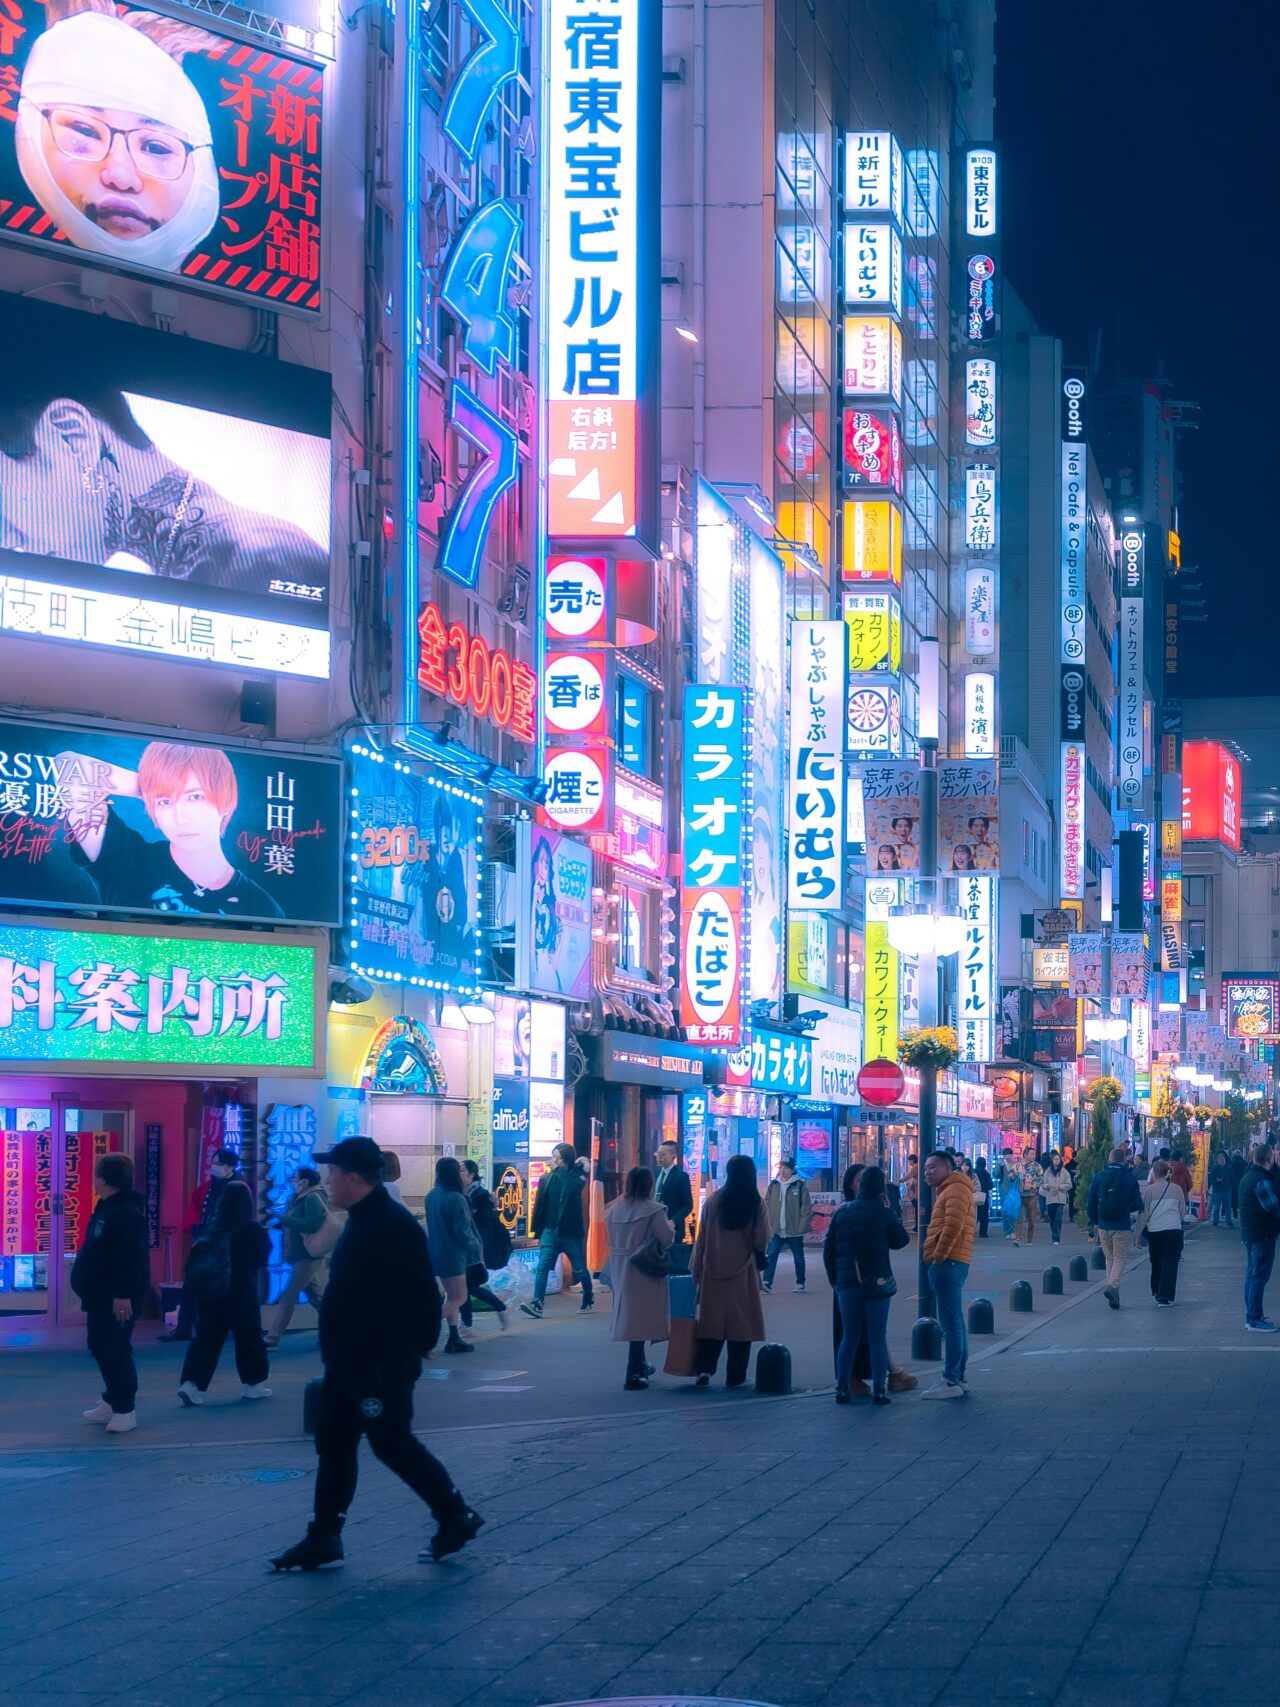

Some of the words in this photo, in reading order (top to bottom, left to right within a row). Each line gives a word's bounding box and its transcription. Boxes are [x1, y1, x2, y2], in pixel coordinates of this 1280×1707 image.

[219, 75, 268, 257] オープン
[264, 86, 320, 281] 新店舗
[856, 136, 880, 208] 川新ビル
[563, 0, 623, 396] 宿東宝ビル店
[973, 166, 990, 229] 東京ビル
[857, 228, 878, 300] にいむら
[860, 324, 878, 391] ととりこ
[570, 407, 613, 426] 右斜
[853, 412, 881, 471] おすすめ
[849, 473, 861, 484] 7F
[974, 464, 989, 472] 5F
[1068, 452, 1080, 477] Net
[1068, 482, 1080, 517] Cafe
[1068, 523, 1080, 532] &
[861, 570, 873, 579] 6F
[1066, 537, 1080, 598] Capsule
[548, 580, 583, 614] 売
[585, 589, 602, 607] た
[1126, 604, 1138, 672] ネットカフェ
[806, 628, 828, 743] しゃぶしゃぶ
[876, 660, 890, 671] 5F
[1127, 677, 1137, 688] &
[548, 674, 582, 709] 香
[584, 684, 601, 700] ば
[1126, 692, 1138, 738] カプセル
[548, 770, 583, 804] 煙
[688, 691, 738, 888] カラオケ
[862, 767, 895, 784] 忘年
[939, 766, 973, 784] 忘年
[1065, 756, 1081, 810] カラオケ
[548, 807, 595, 815] CIGARETTE
[793, 746, 837, 901] にいむら
[1063, 822, 1081, 897] まねきねこ
[1165, 872, 1178, 880] 4F
[966, 876, 983, 921] 茶室
[1163, 881, 1180, 910] 麻雀
[694, 907, 730, 1009] たばこ
[963, 927, 987, 1011] ルノアール
[1162, 924, 1182, 970] CASINO
[686, 1024, 735, 1042] 直売所
[752, 1034, 811, 1088] カラオケ
[820, 1065, 858, 1097] にいむら
